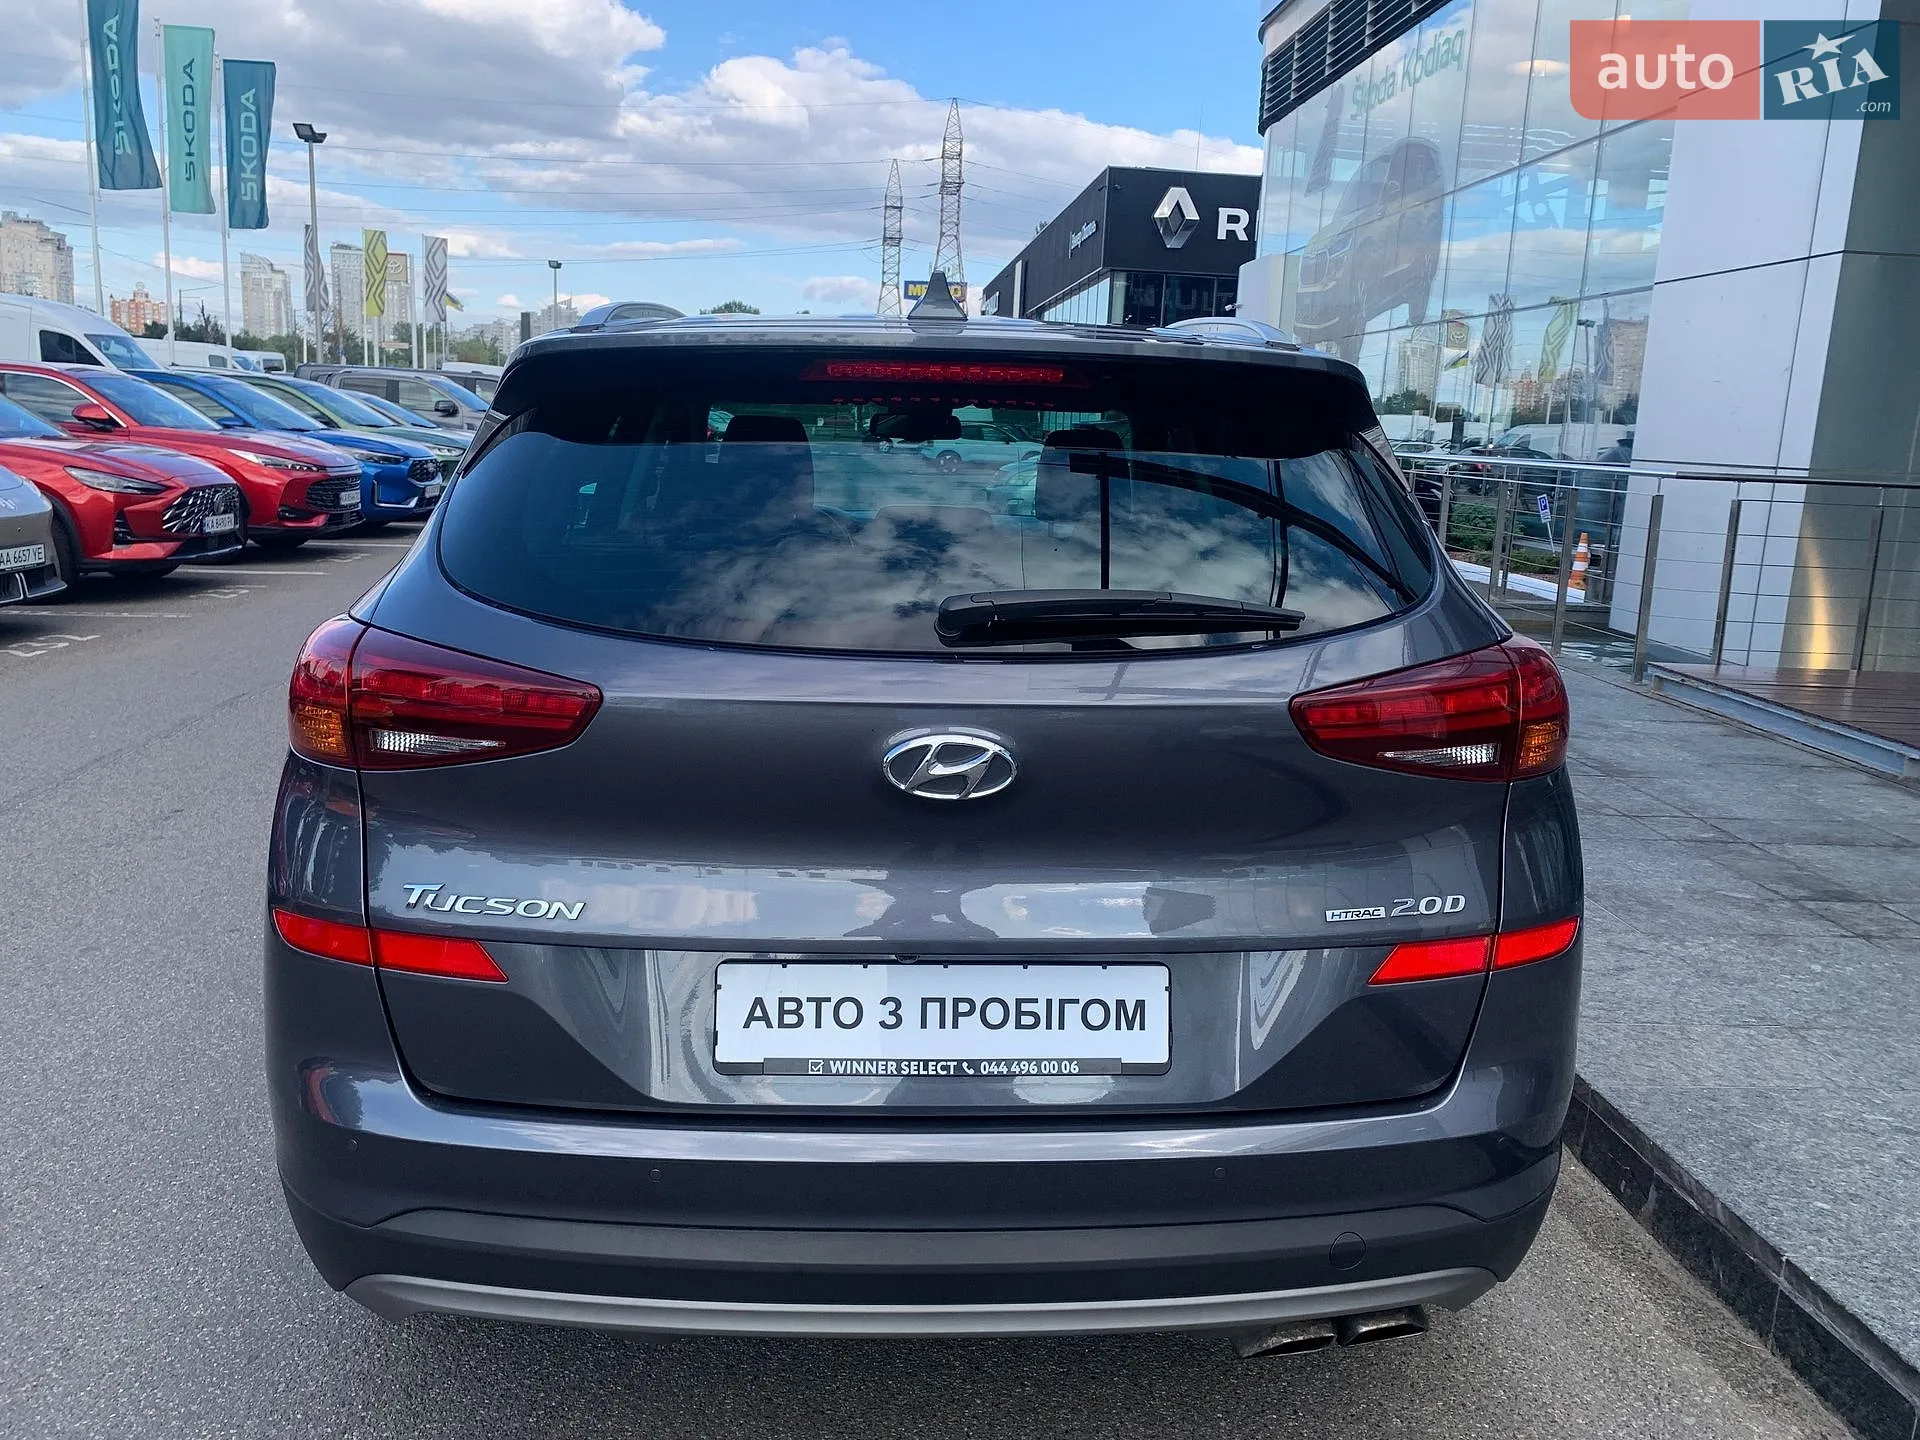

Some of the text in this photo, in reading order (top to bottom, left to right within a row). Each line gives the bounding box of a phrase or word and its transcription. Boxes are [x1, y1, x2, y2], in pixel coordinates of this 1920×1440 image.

[1217, 207, 1259, 242] R
[1331, 908, 1382, 920] HTRAC
[742, 996, 1147, 1032] АВТО З ПРОБІГОМ
[830, 1060, 1079, 1075] WINNER SELECT 044 496 00 06
